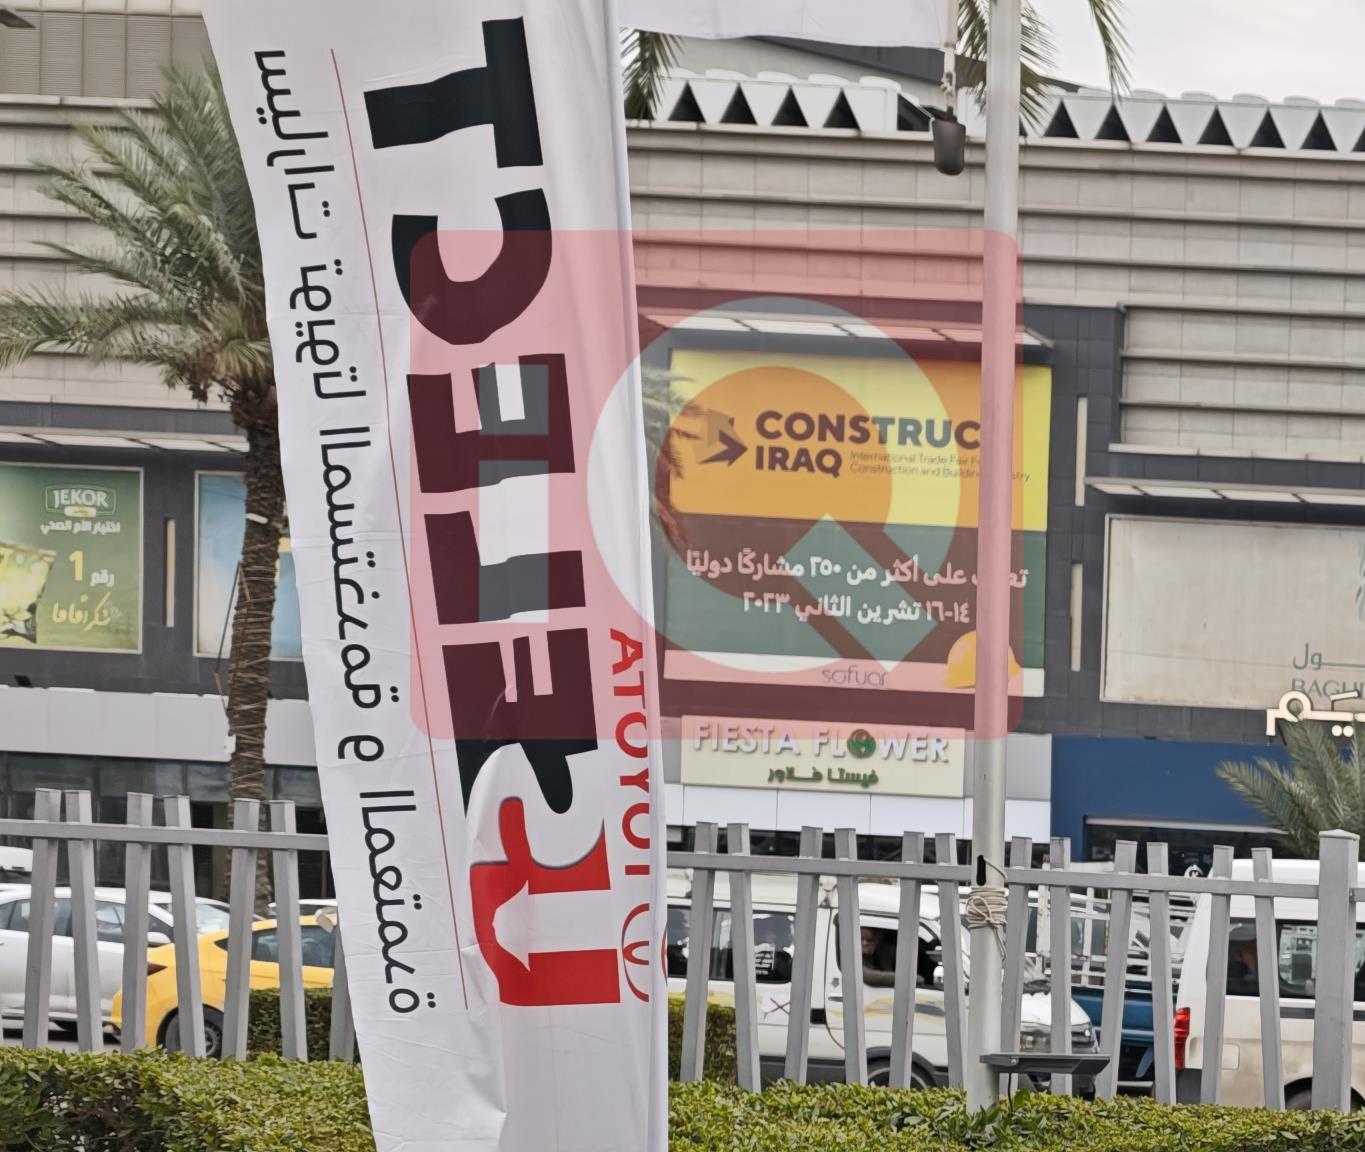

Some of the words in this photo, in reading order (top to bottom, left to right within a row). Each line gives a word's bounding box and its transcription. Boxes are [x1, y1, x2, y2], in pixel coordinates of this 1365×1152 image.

[755, 445, 842, 478] IRAQ
[919, 453, 948, 464] Trade
[53, 489, 109, 508] JEKOR
[68, 550, 84, 581] 1
[810, 556, 842, 576] ٢٥٠
[847, 566, 877, 585] من
[880, 554, 919, 587] أكثر
[924, 562, 966, 587] على
[795, 594, 852, 622] الثاني
[857, 599, 921, 625] تشرين
[693, 721, 801, 756] FIESTA
[768, 766, 823, 783] فلاور
[827, 767, 879, 788] فيستا
